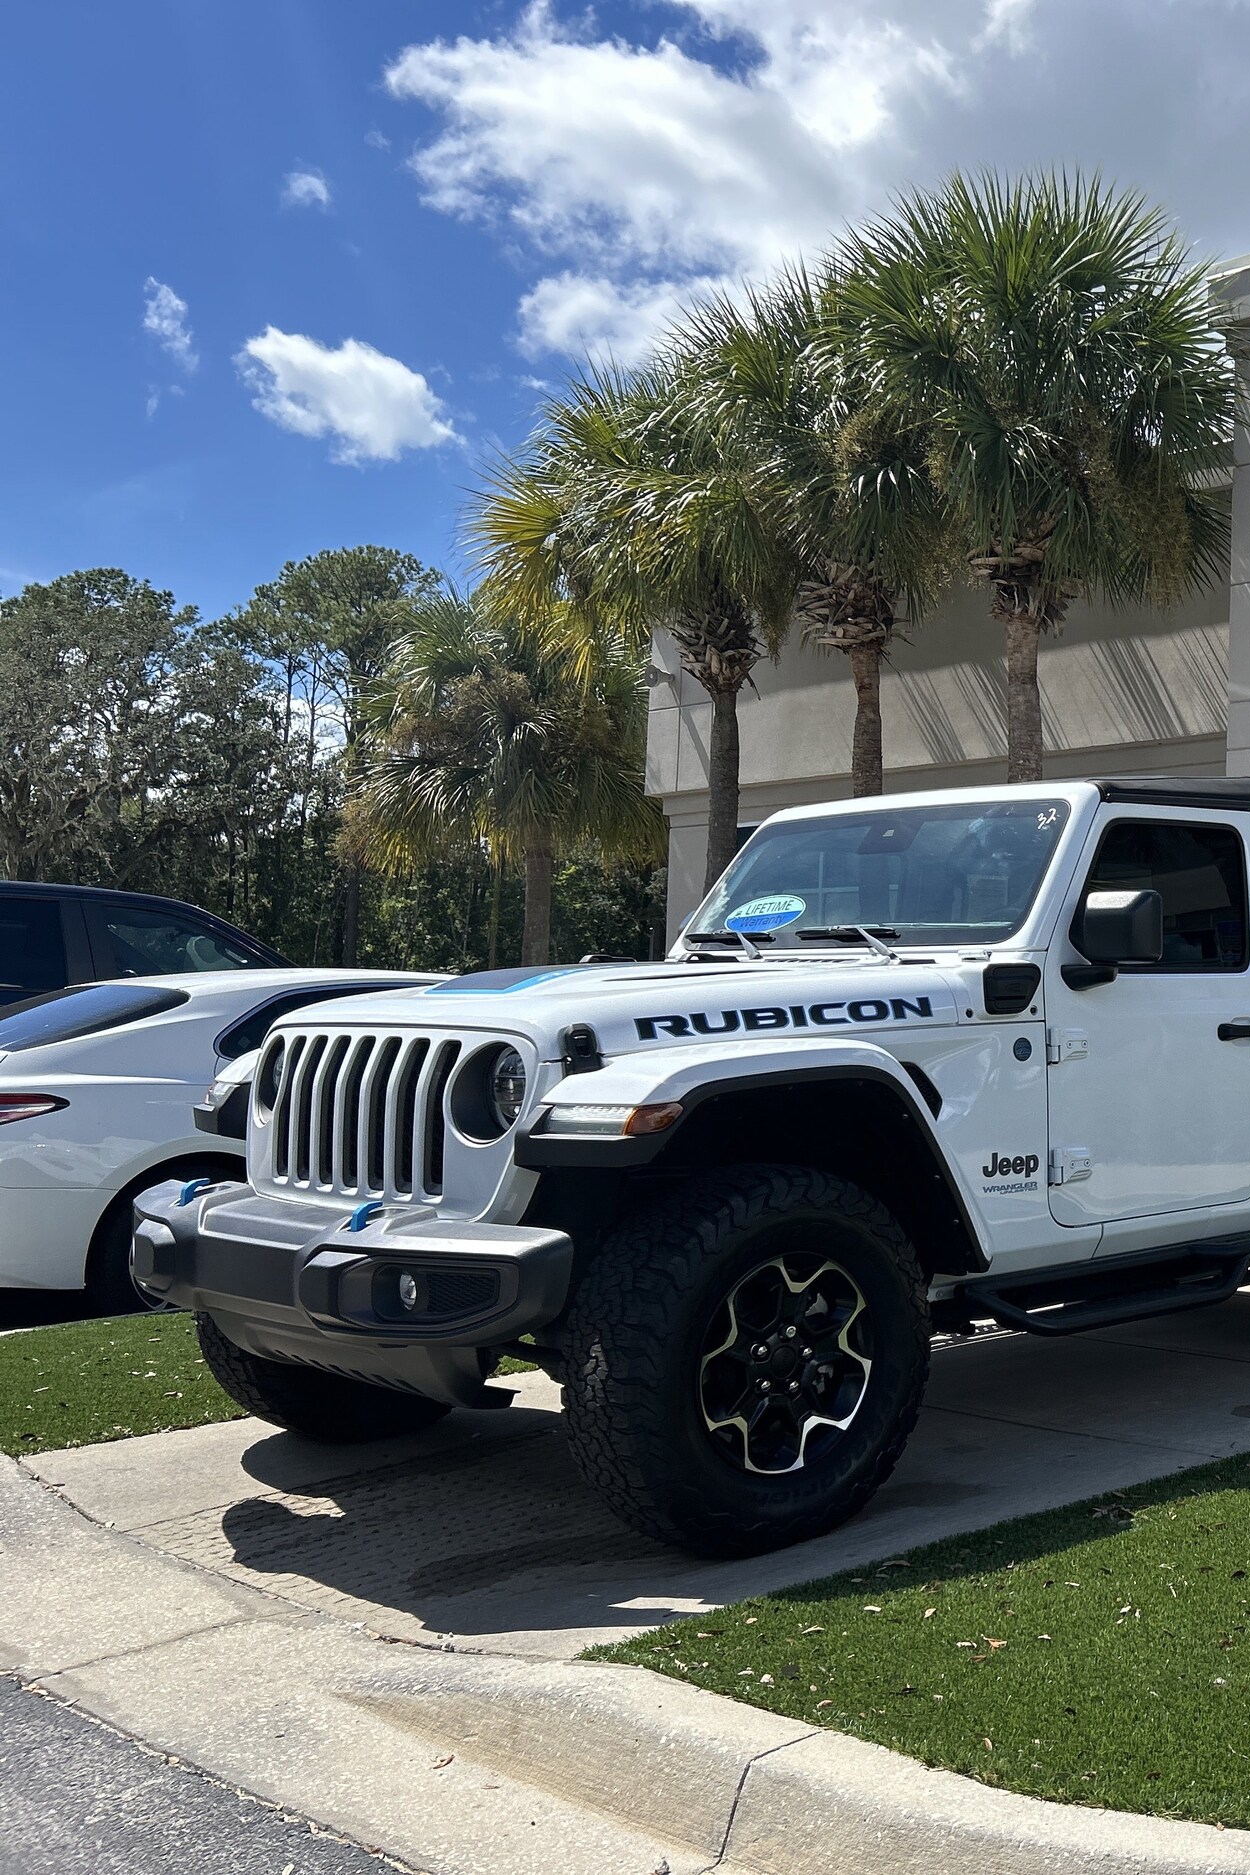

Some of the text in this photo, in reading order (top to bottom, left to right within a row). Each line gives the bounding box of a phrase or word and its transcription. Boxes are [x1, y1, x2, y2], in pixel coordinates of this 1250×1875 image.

[745, 899, 795, 916] LIFETIME
[740, 914, 786, 928] Warranty
[632, 996, 935, 1042] RUBICON
[982, 1152, 1040, 1178] Jeep
[982, 1181, 1039, 1194] WRANGLER
